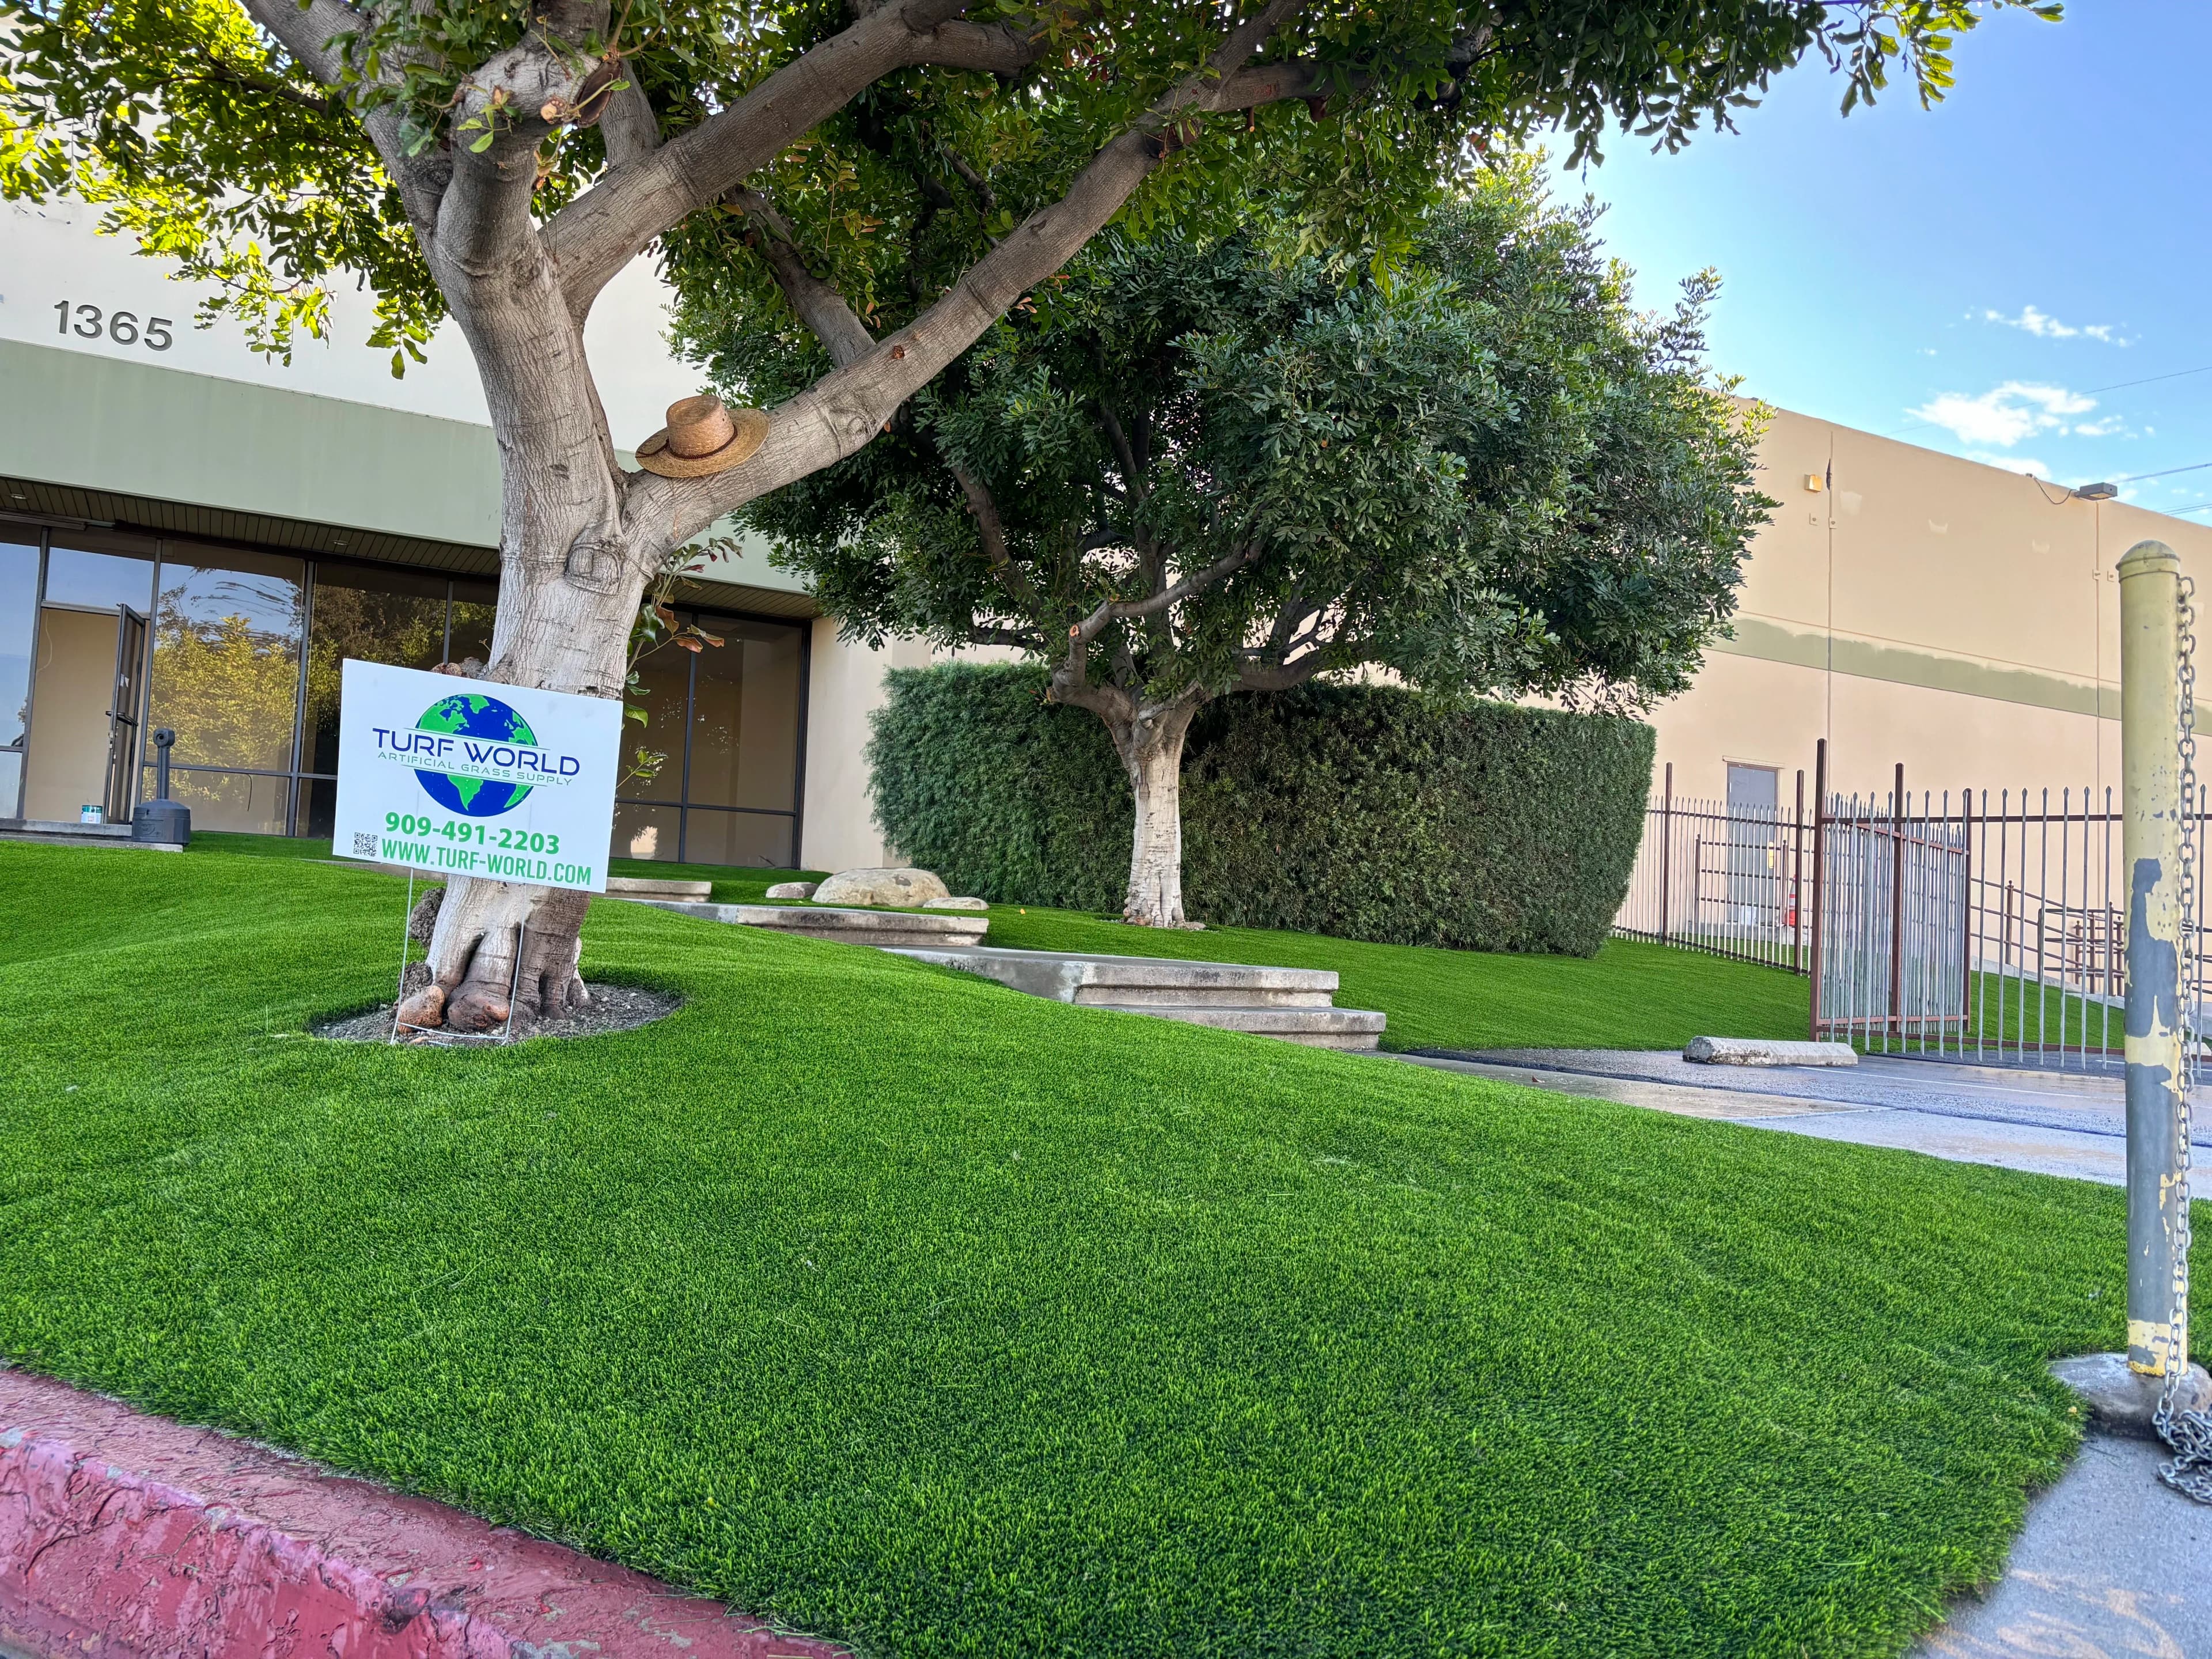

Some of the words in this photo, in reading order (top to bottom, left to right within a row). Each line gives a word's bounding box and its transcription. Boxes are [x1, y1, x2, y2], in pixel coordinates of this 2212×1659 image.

[54, 300, 173, 351] 1365
[372, 728, 454, 757] TURF
[464, 741, 580, 776] WORLD
[377, 751, 455, 770] ARTIFICIAL
[461, 764, 510, 778] GRASS
[516, 772, 572, 786] SUPPLY
[385, 812, 560, 854] 909-491-2203
[381, 838, 592, 885] WWW.TURF-WORLD.COM
